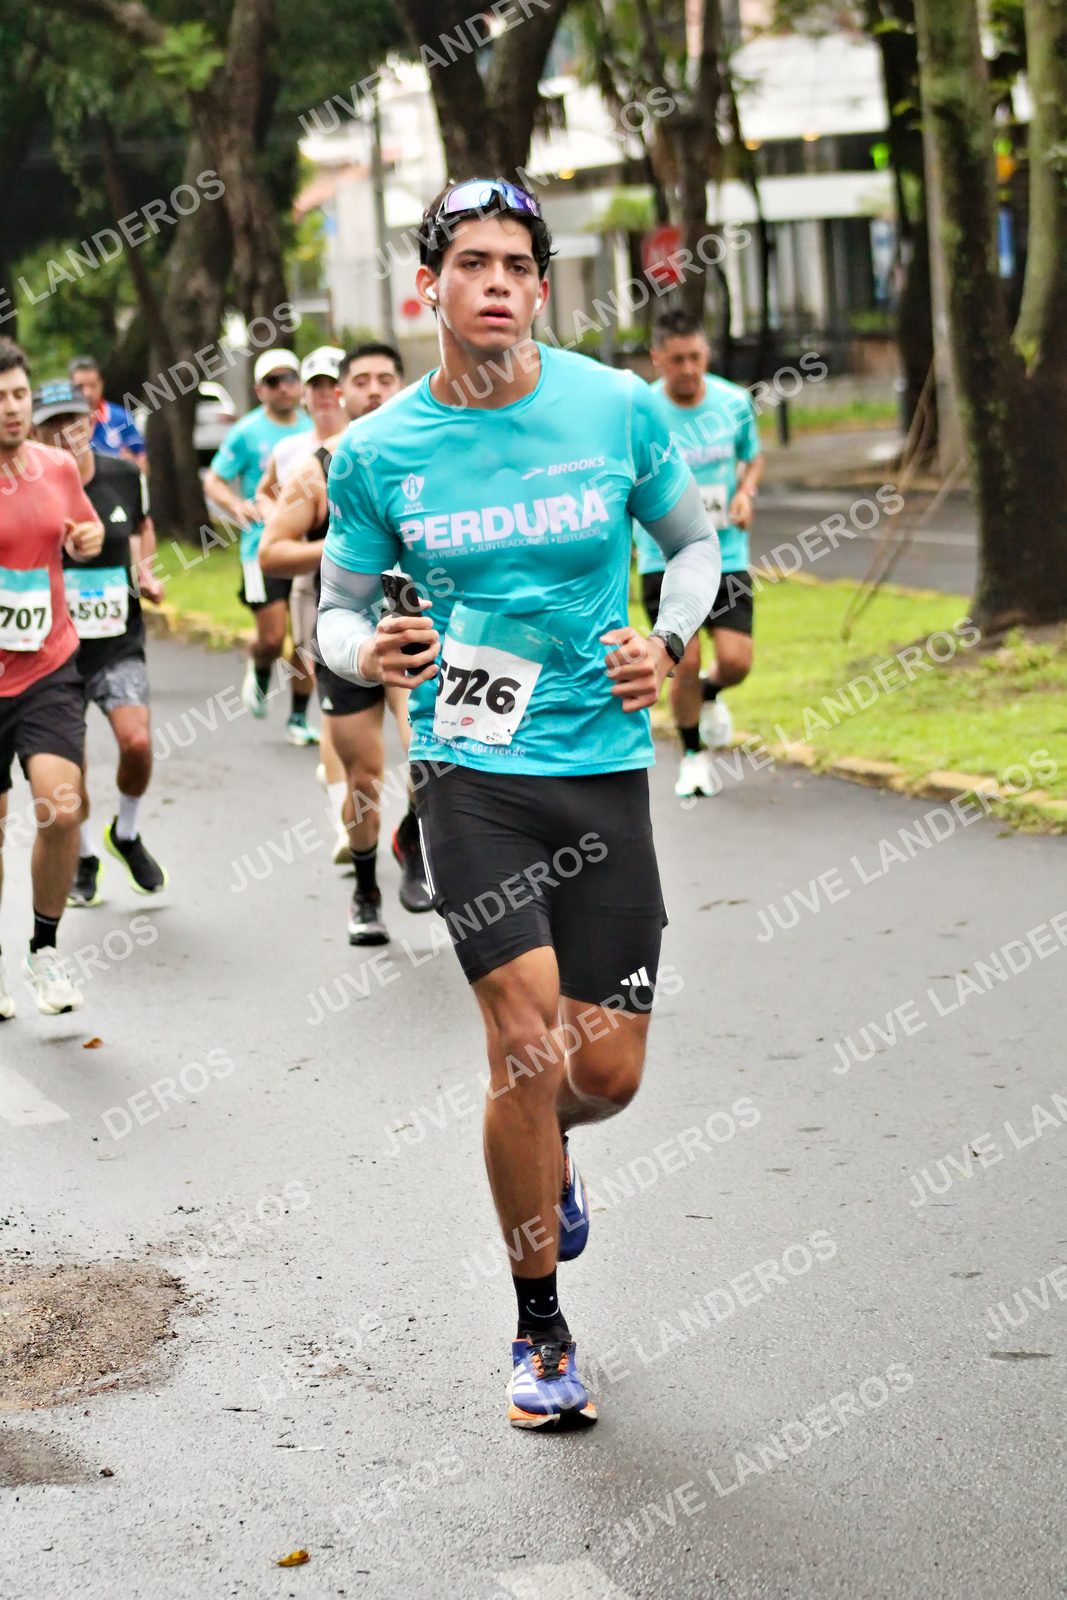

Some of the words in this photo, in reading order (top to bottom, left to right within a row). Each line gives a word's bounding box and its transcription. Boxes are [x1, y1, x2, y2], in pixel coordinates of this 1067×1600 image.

[547, 456, 605, 476] BROOKS
[399, 489, 609, 551] PERDURA
[439, 546, 468, 558] PISOS
[0, 606, 46, 630] 707
